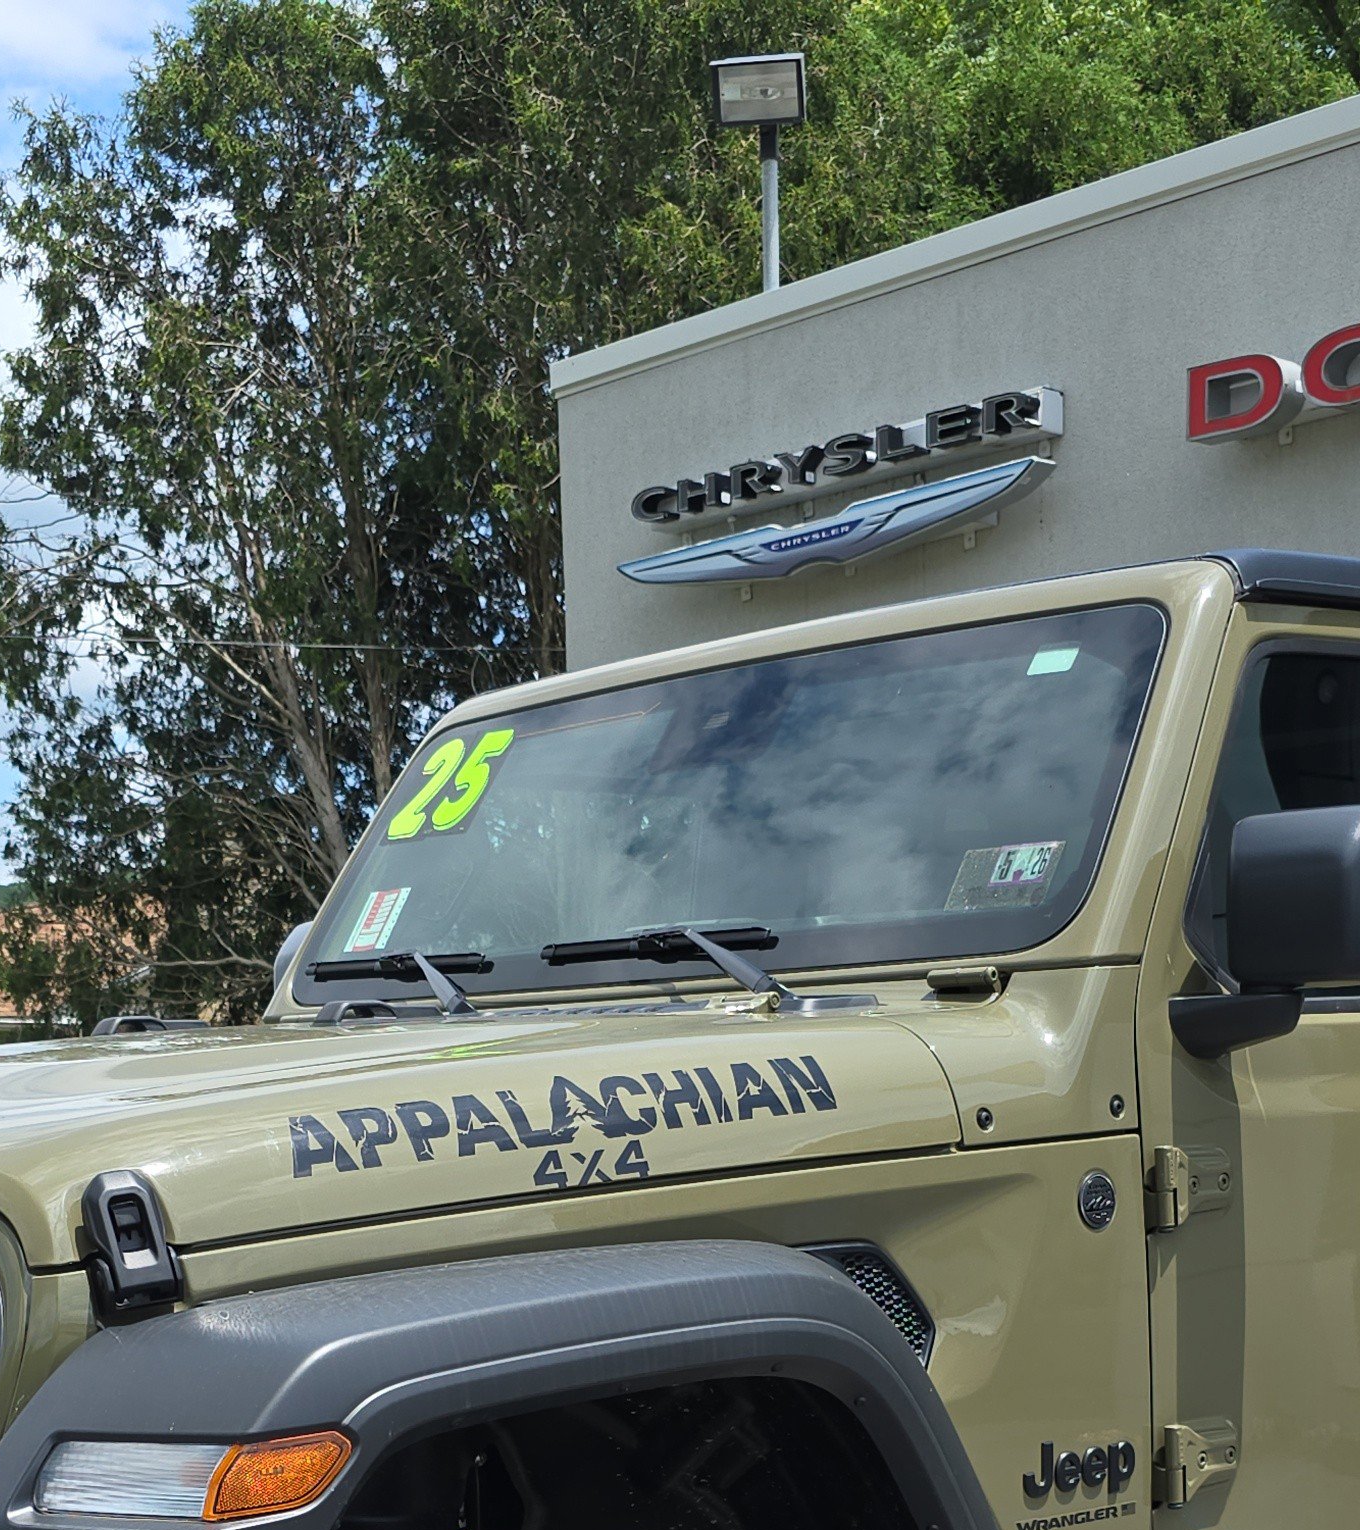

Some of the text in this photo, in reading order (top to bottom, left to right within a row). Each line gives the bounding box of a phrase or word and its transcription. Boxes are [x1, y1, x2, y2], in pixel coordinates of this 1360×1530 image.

[631, 392, 1041, 523] CHRYSLER
[770, 524, 851, 552] CHRYSLER
[388, 729, 514, 841] 25
[289, 1055, 838, 1179] APPALACHIAN
[1022, 1440, 1136, 1499] Jeep
